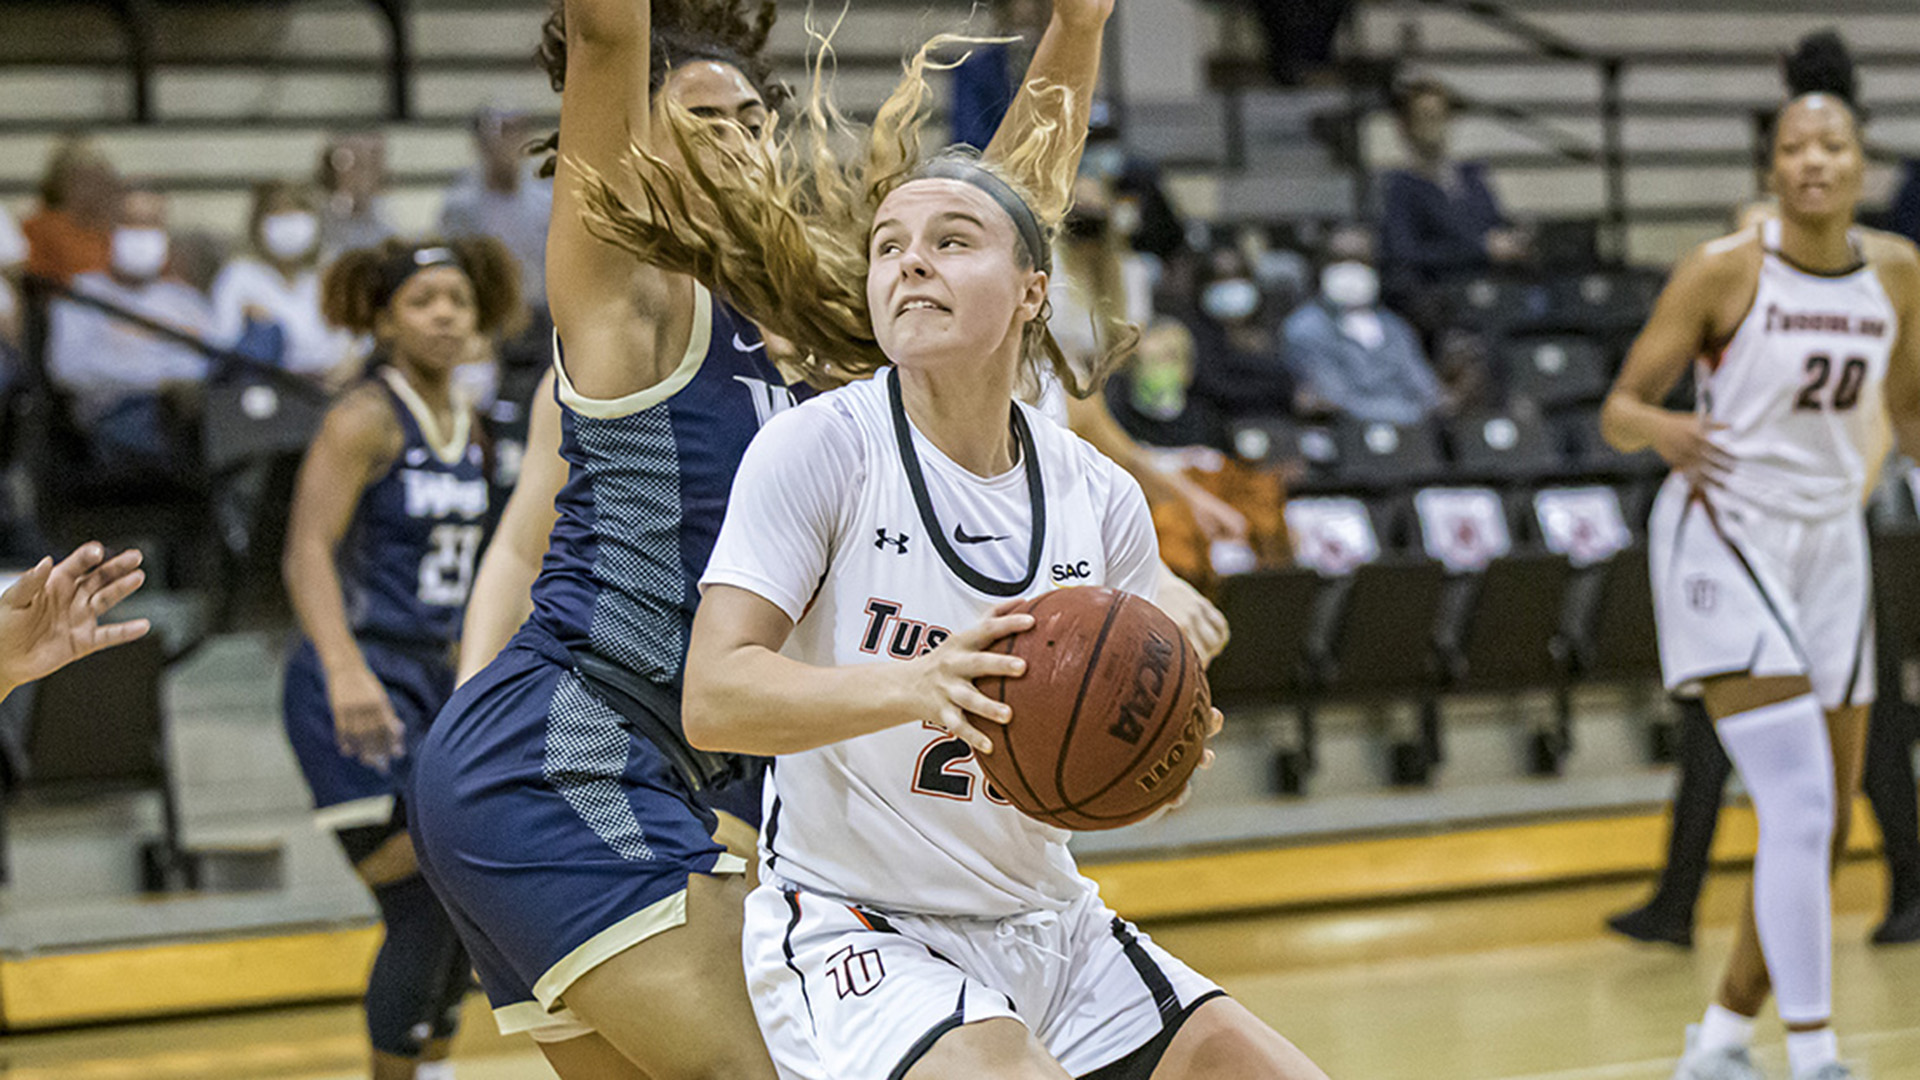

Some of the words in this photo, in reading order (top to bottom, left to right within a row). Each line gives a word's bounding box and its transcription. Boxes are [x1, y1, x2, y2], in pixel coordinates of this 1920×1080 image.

[1792, 352, 1866, 412] 20
[1051, 560, 1091, 581] SAC
[1108, 630, 1174, 746] NCAA
[911, 719, 1013, 806] 2
[825, 944, 886, 1000] TU
